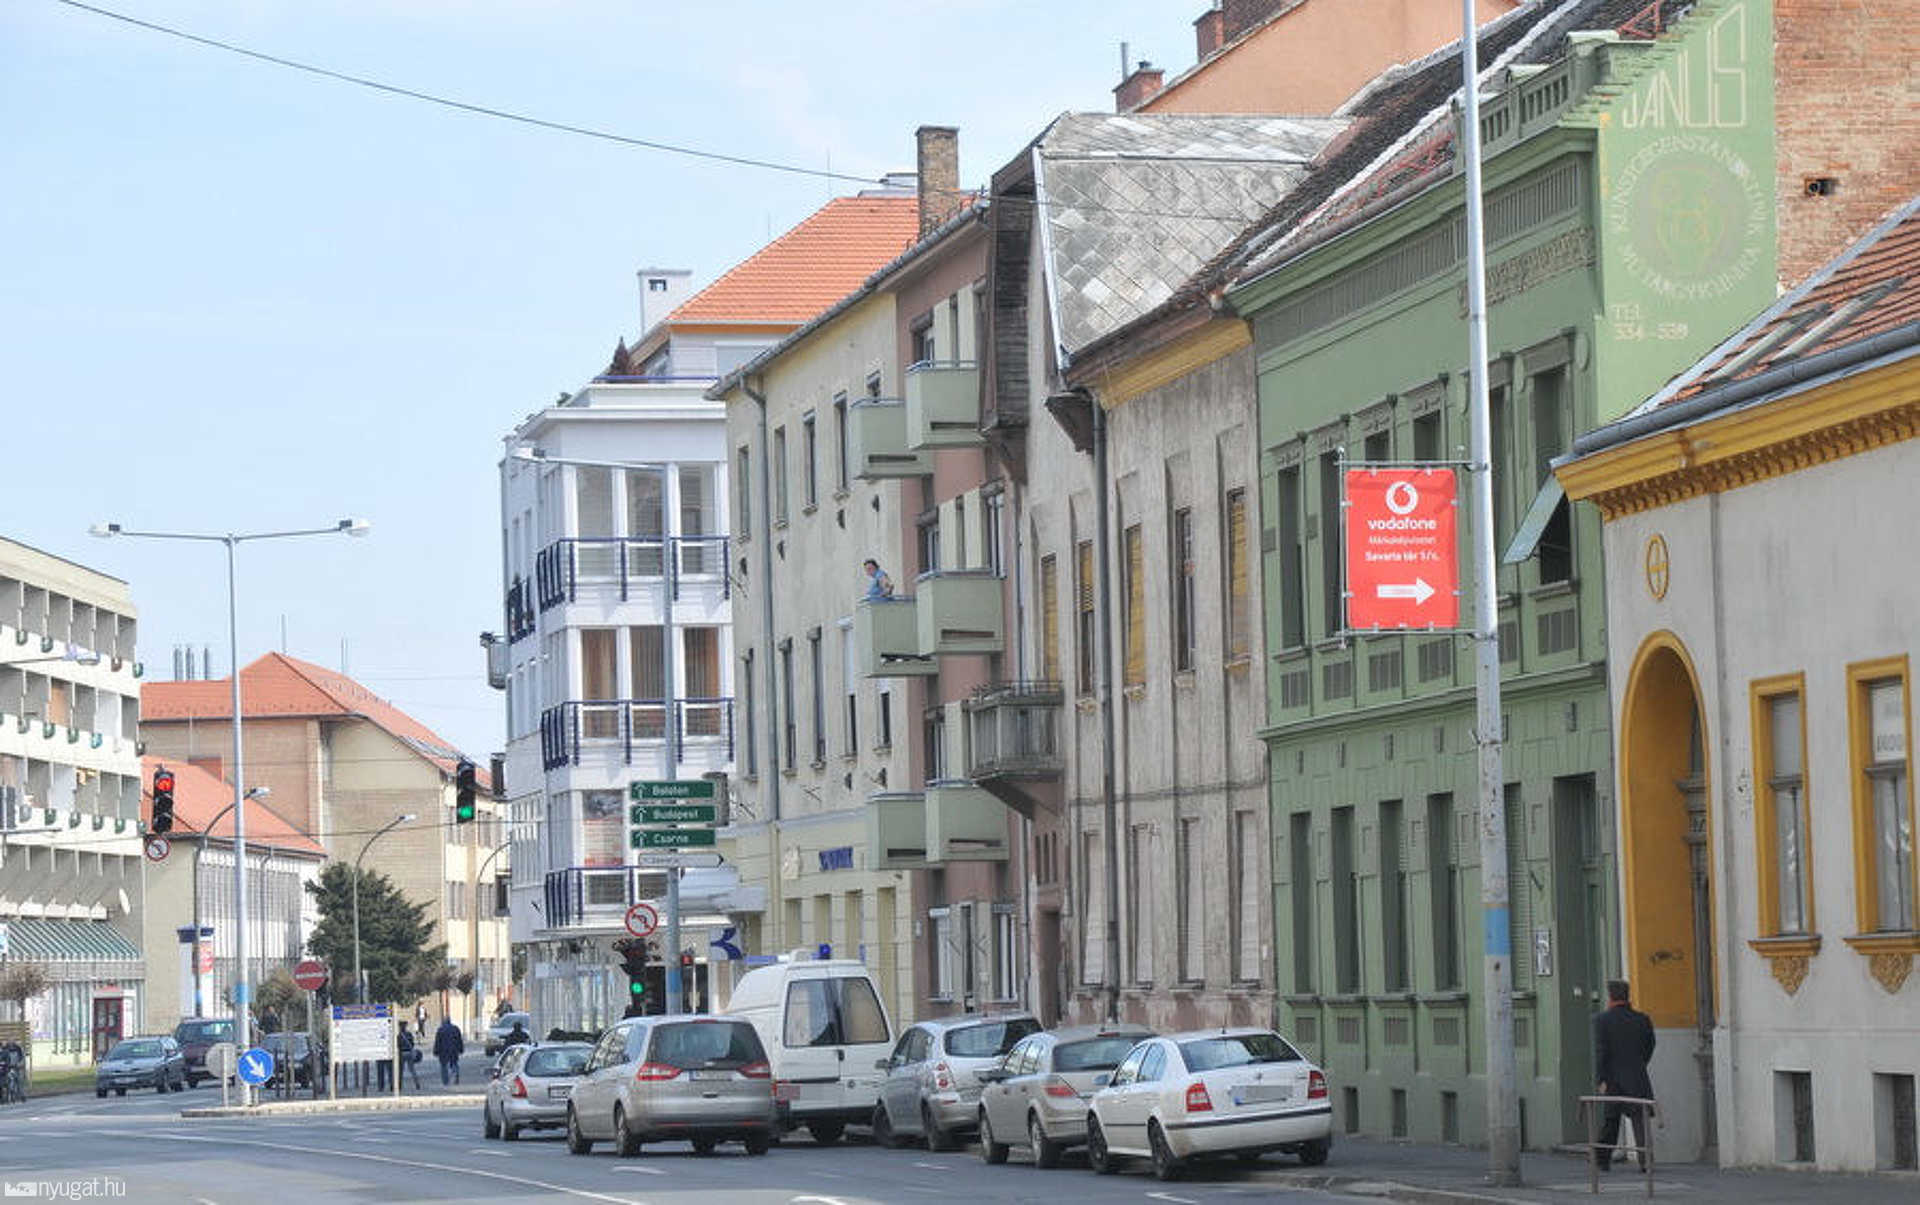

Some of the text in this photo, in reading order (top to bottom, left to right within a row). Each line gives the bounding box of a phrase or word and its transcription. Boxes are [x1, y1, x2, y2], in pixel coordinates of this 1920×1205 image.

[1622, 2, 1747, 128] JANUS
[1367, 517, 1437, 530] vodafone
[653, 809, 699, 821] Budapest
[653, 833, 690, 844] Csorna
